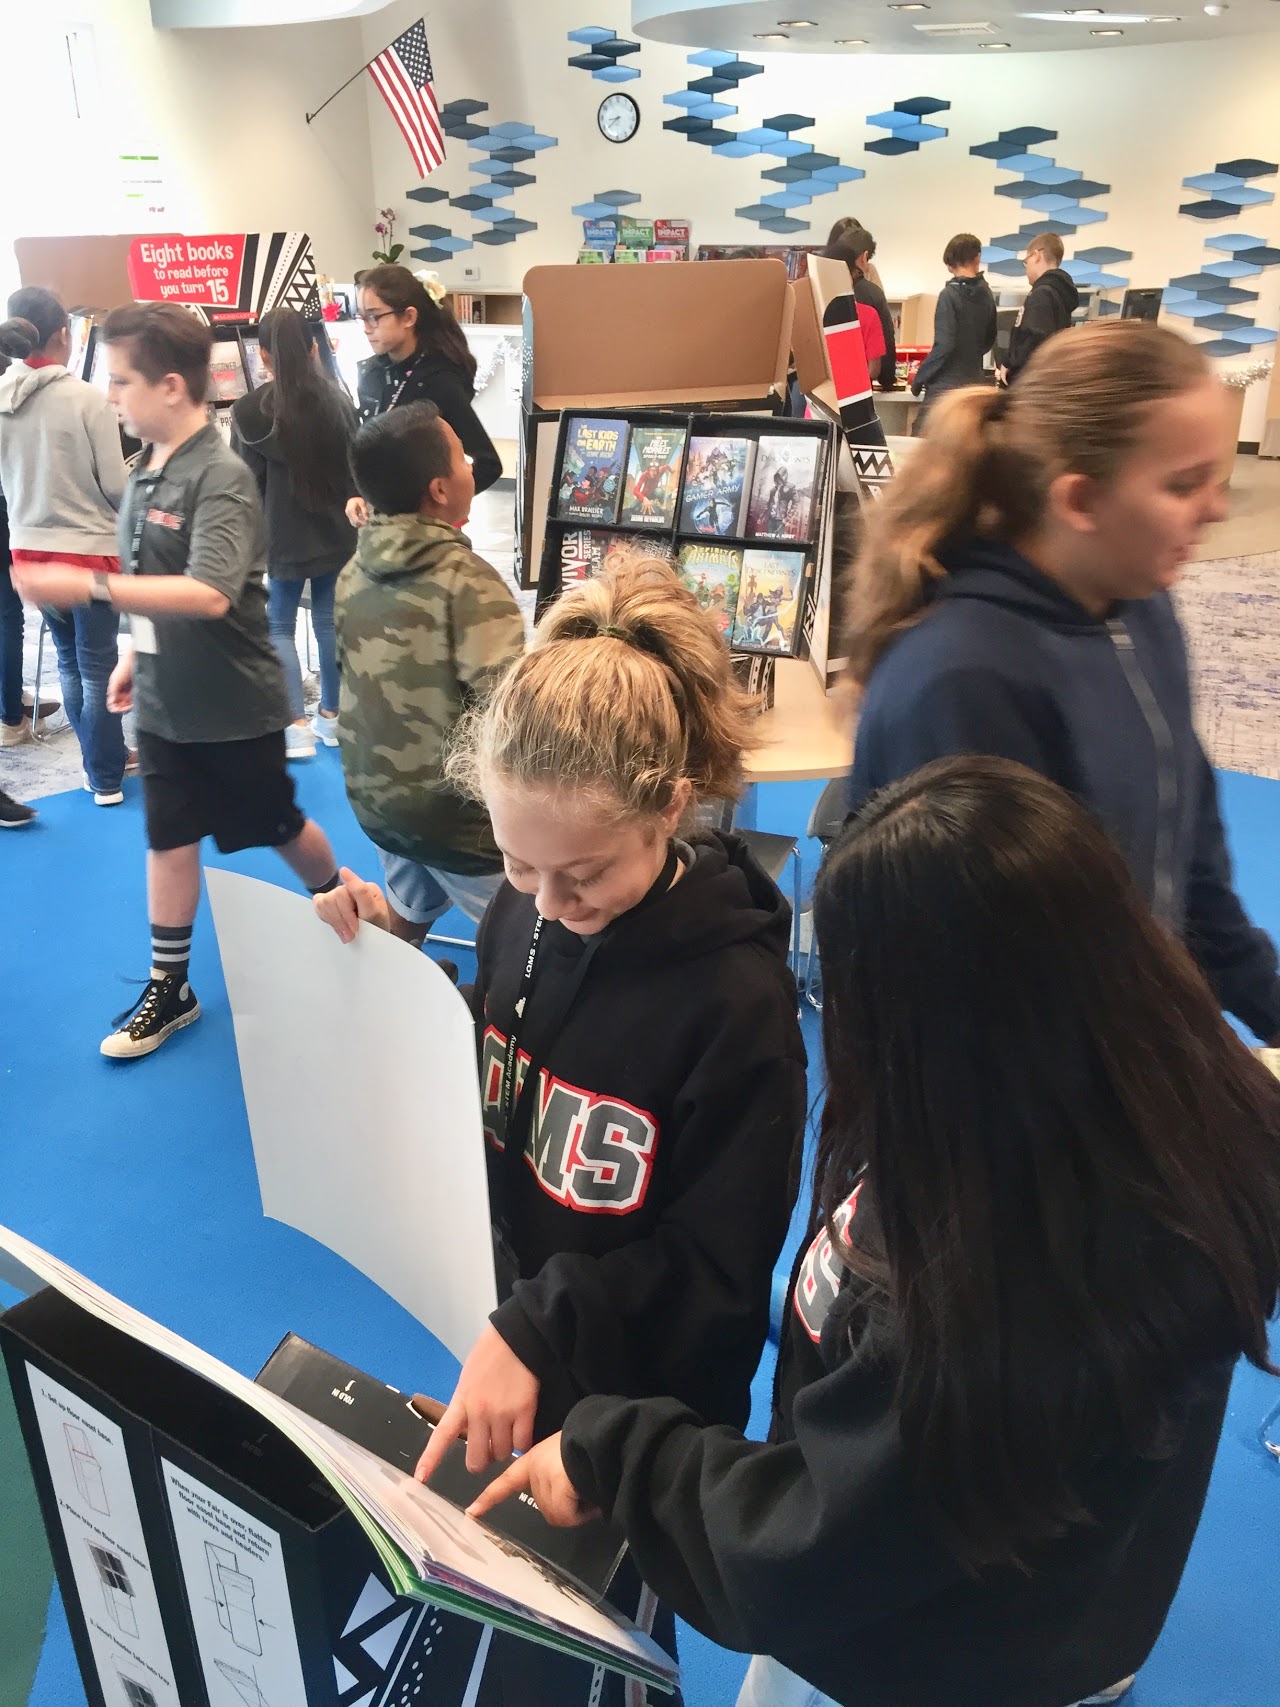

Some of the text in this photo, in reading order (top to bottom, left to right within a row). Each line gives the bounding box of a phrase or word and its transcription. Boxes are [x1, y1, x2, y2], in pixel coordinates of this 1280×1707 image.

[140, 241, 234, 269] Eight books
[153, 264, 229, 280] to read before
[160, 278, 229, 303] you turn 15
[577, 429, 619, 440] LAST KIDS
[586, 439, 617, 452] EARTH
[686, 483, 740, 503] GAMER ARMY
[583, 529, 592, 560] SERIES
[561, 532, 592, 592] VIVOR
[525, 948, 536, 978] LQMS
[508, 1034, 517, 1080] Academy
[482, 1024, 660, 1217] QMS
[331, 1387, 355, 1405] FOLD IN
[518, 1492, 529, 1503] IN
[170, 1476, 190, 1493] When
[191, 1491, 206, 1504] your
[207, 1501, 221, 1514] Fair
[230, 1517, 247, 1533] over,
[248, 1527, 273, 1549] flatten
[178, 1490, 270, 1557] floor easel base and return
[186, 1506, 265, 1563] with trays and headers.
